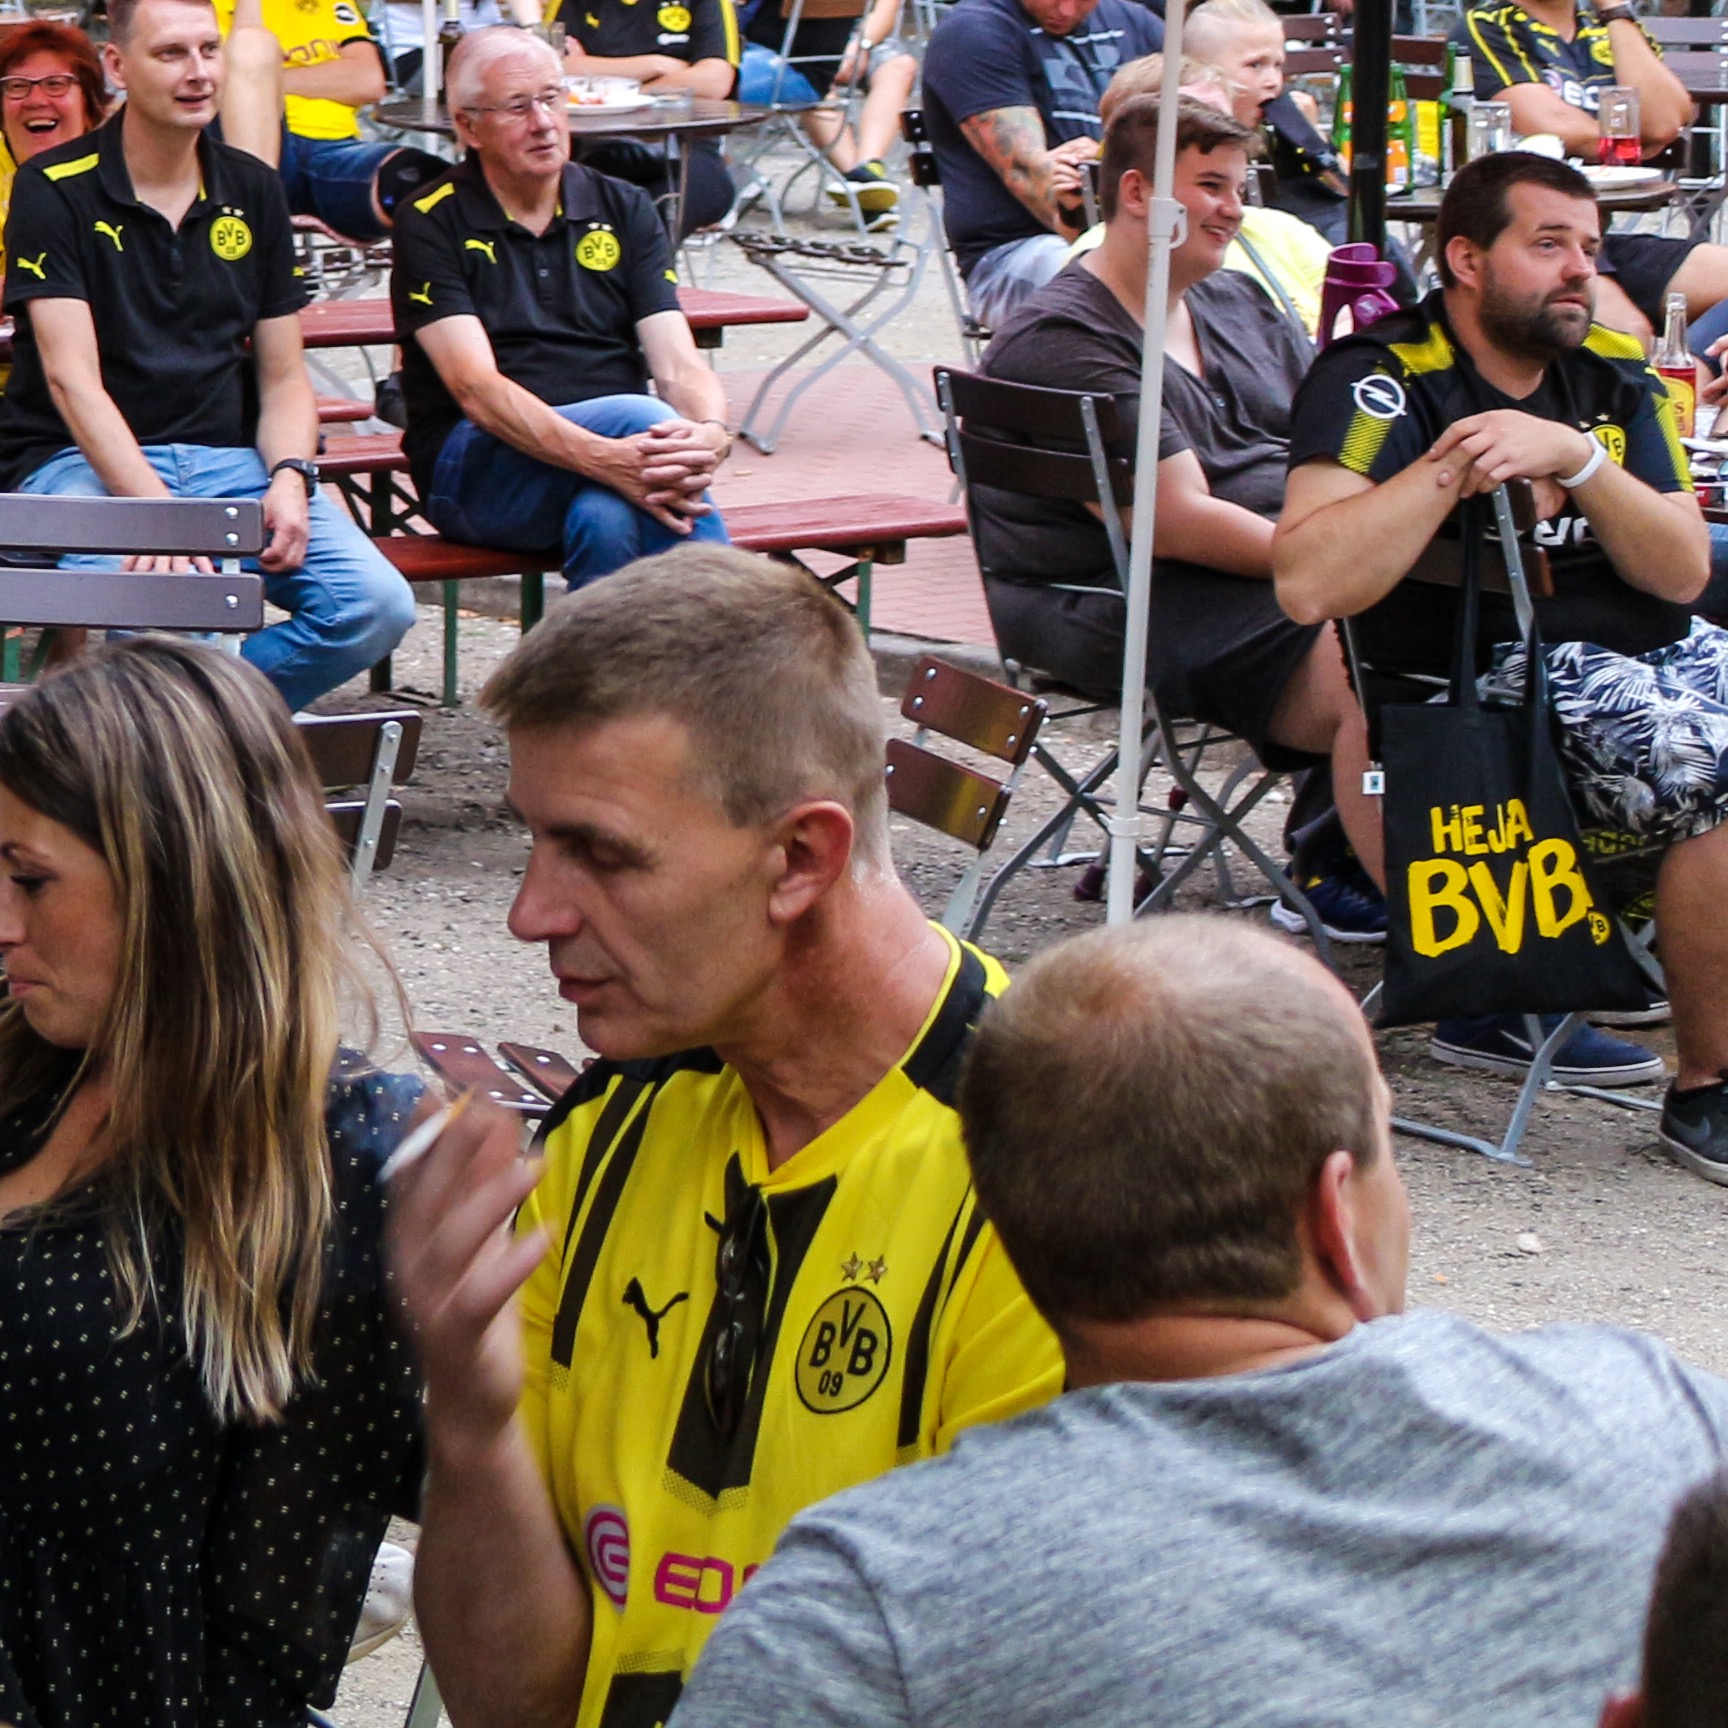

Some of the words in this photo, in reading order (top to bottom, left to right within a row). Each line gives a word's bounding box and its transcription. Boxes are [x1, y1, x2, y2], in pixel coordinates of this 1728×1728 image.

[217, 222, 246, 246] BVB
[584, 236, 615, 260] BVB
[1430, 798, 1534, 856] HEJA
[1408, 838, 1594, 958] BVB
[809, 1299, 880, 1377] BVB
[818, 1370, 844, 1397] 09
